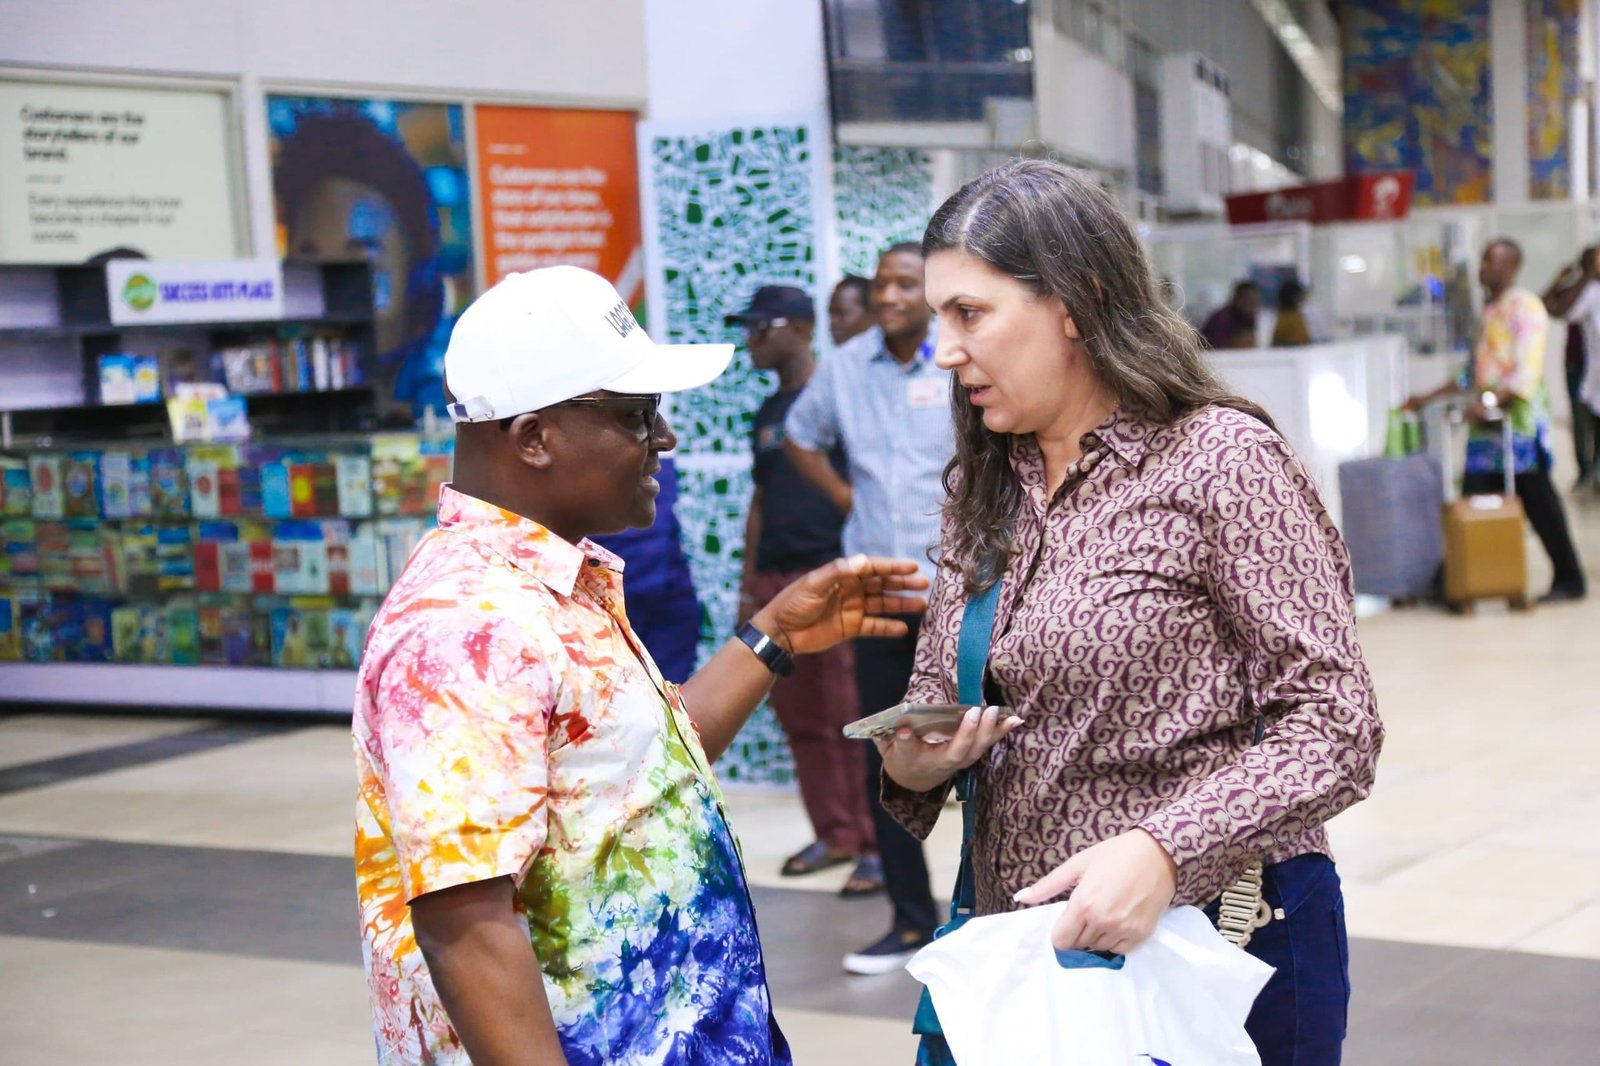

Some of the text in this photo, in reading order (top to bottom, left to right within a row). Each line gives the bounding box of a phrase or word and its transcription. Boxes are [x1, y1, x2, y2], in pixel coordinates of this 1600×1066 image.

[20, 103, 144, 125] Customers are the
[489, 164, 556, 185] Customers
